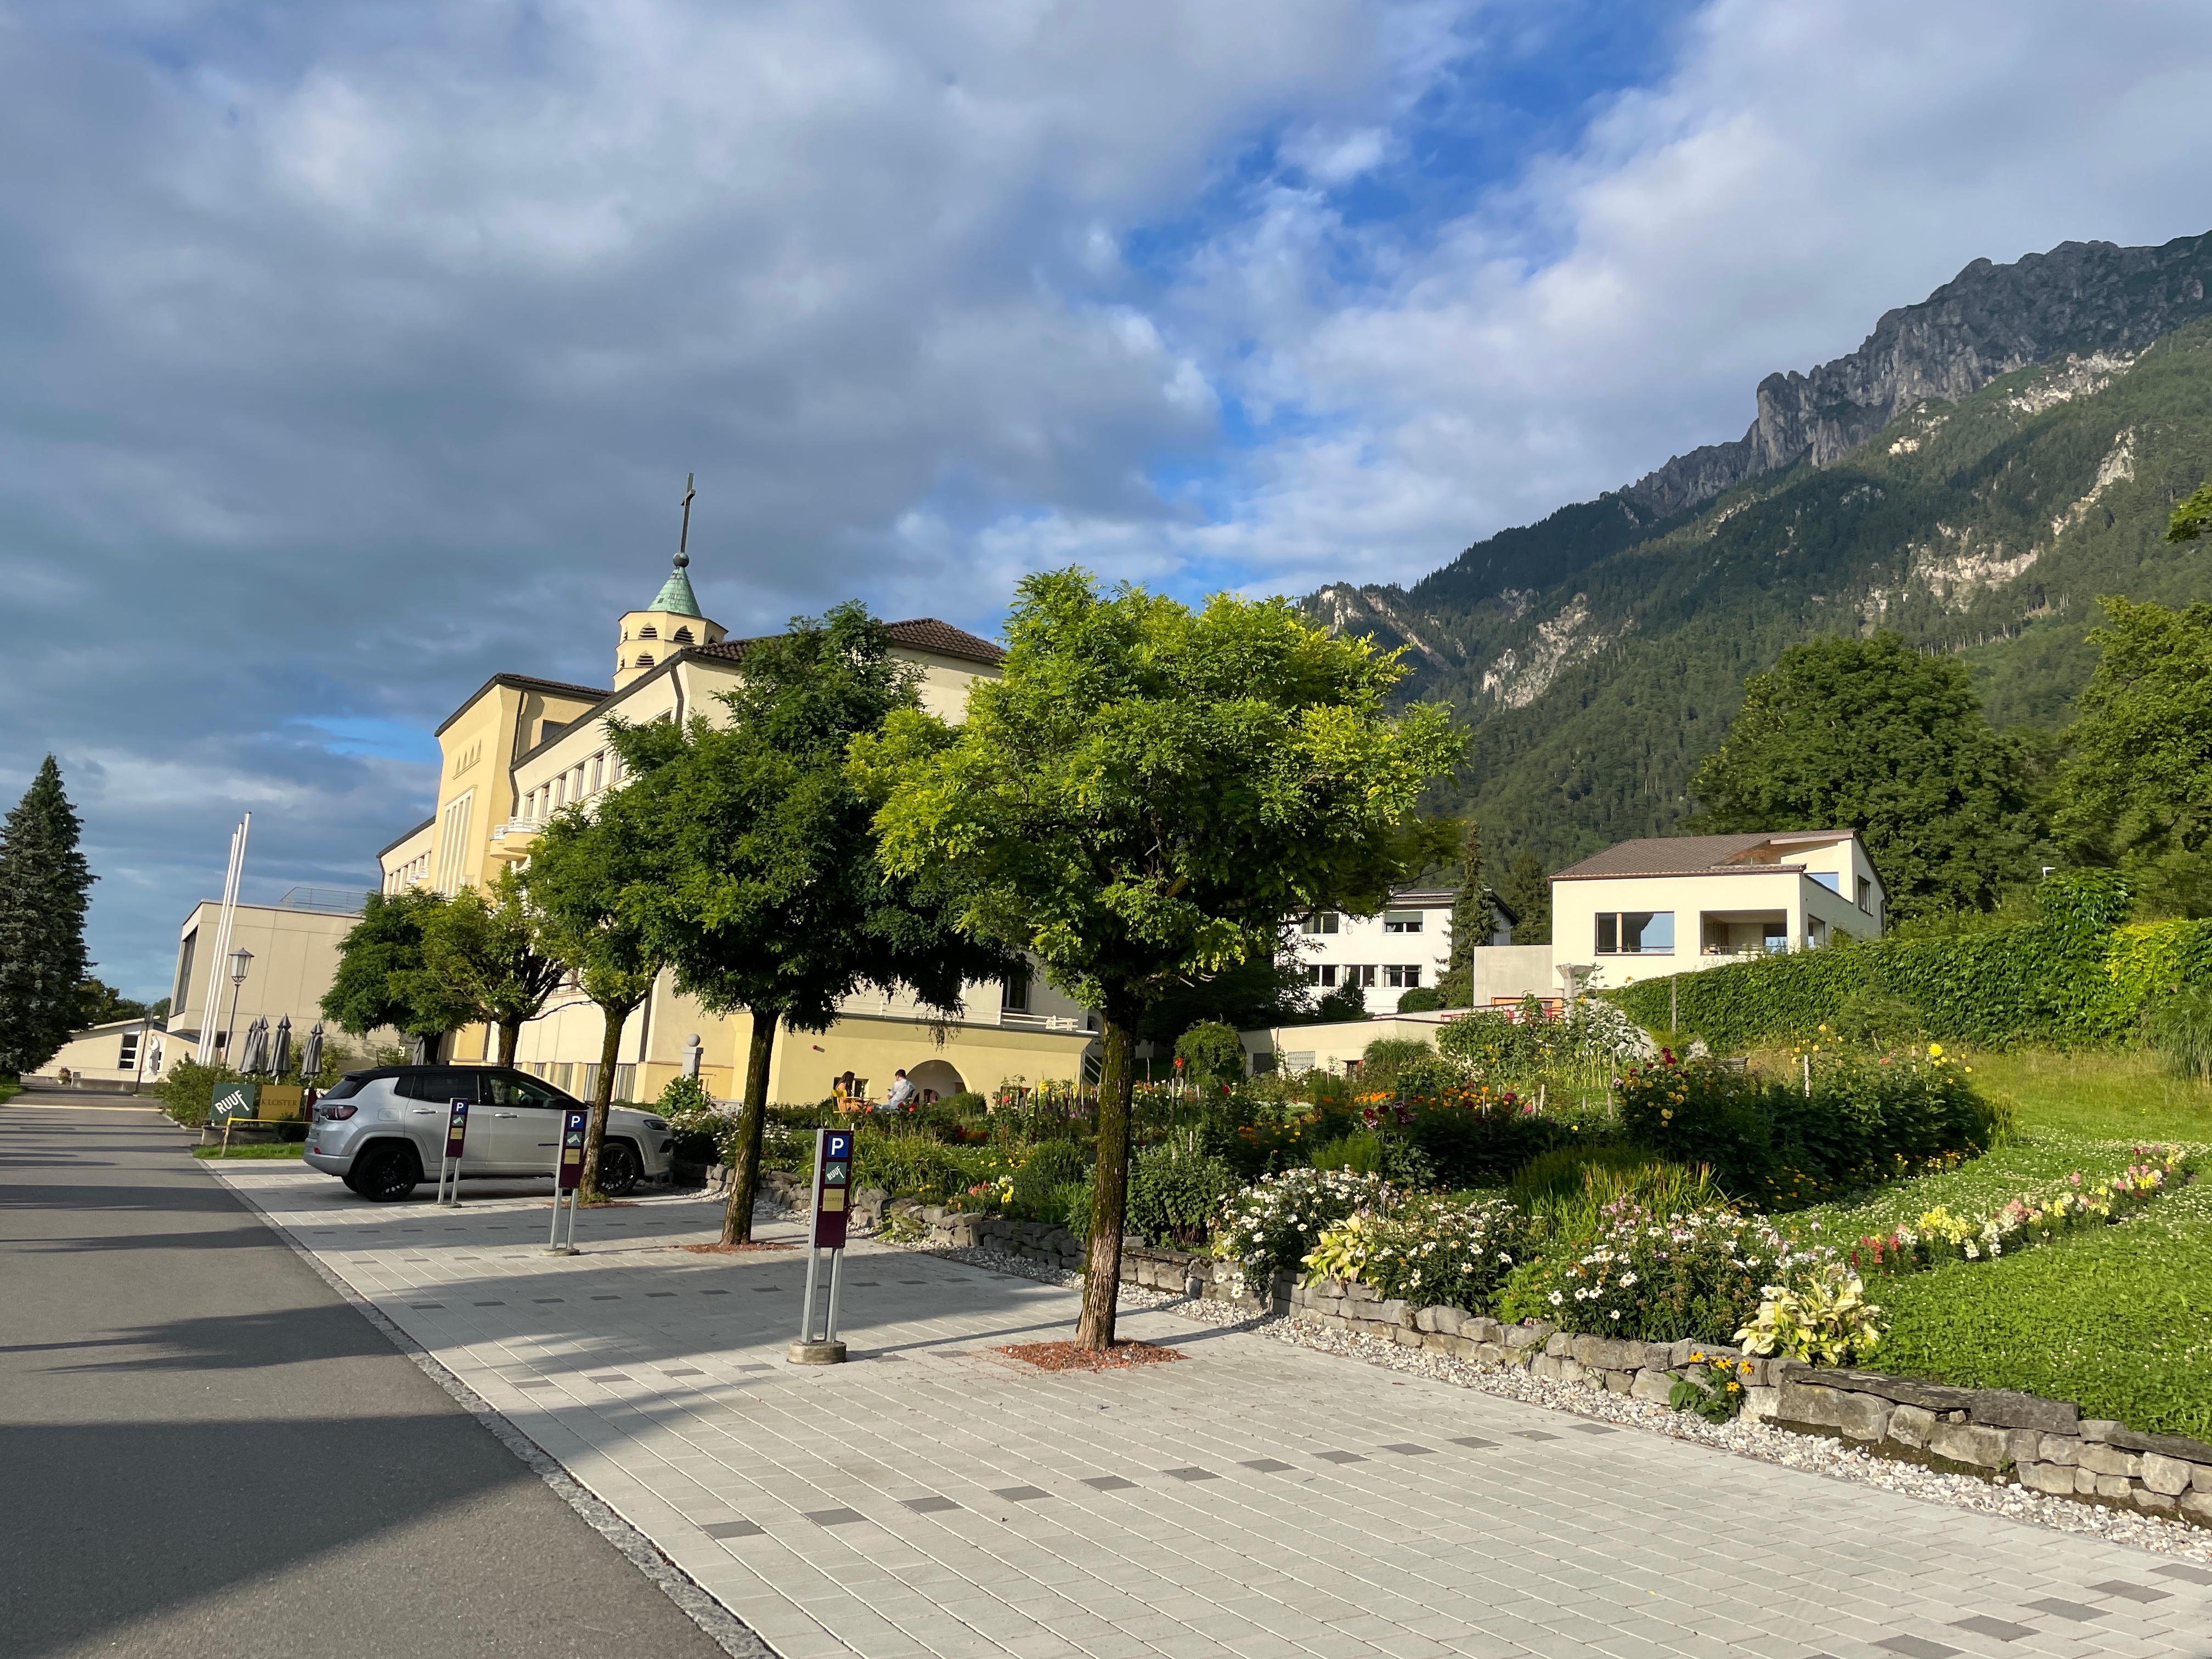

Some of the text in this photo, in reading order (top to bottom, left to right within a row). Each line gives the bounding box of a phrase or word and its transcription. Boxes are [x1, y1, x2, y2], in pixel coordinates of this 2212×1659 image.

[215, 1090, 250, 1114] RUUF
[456, 1102, 464, 1111] P
[571, 1115, 580, 1127] P
[831, 1137, 844, 1155] P
[826, 1165, 844, 1181] RUUF
